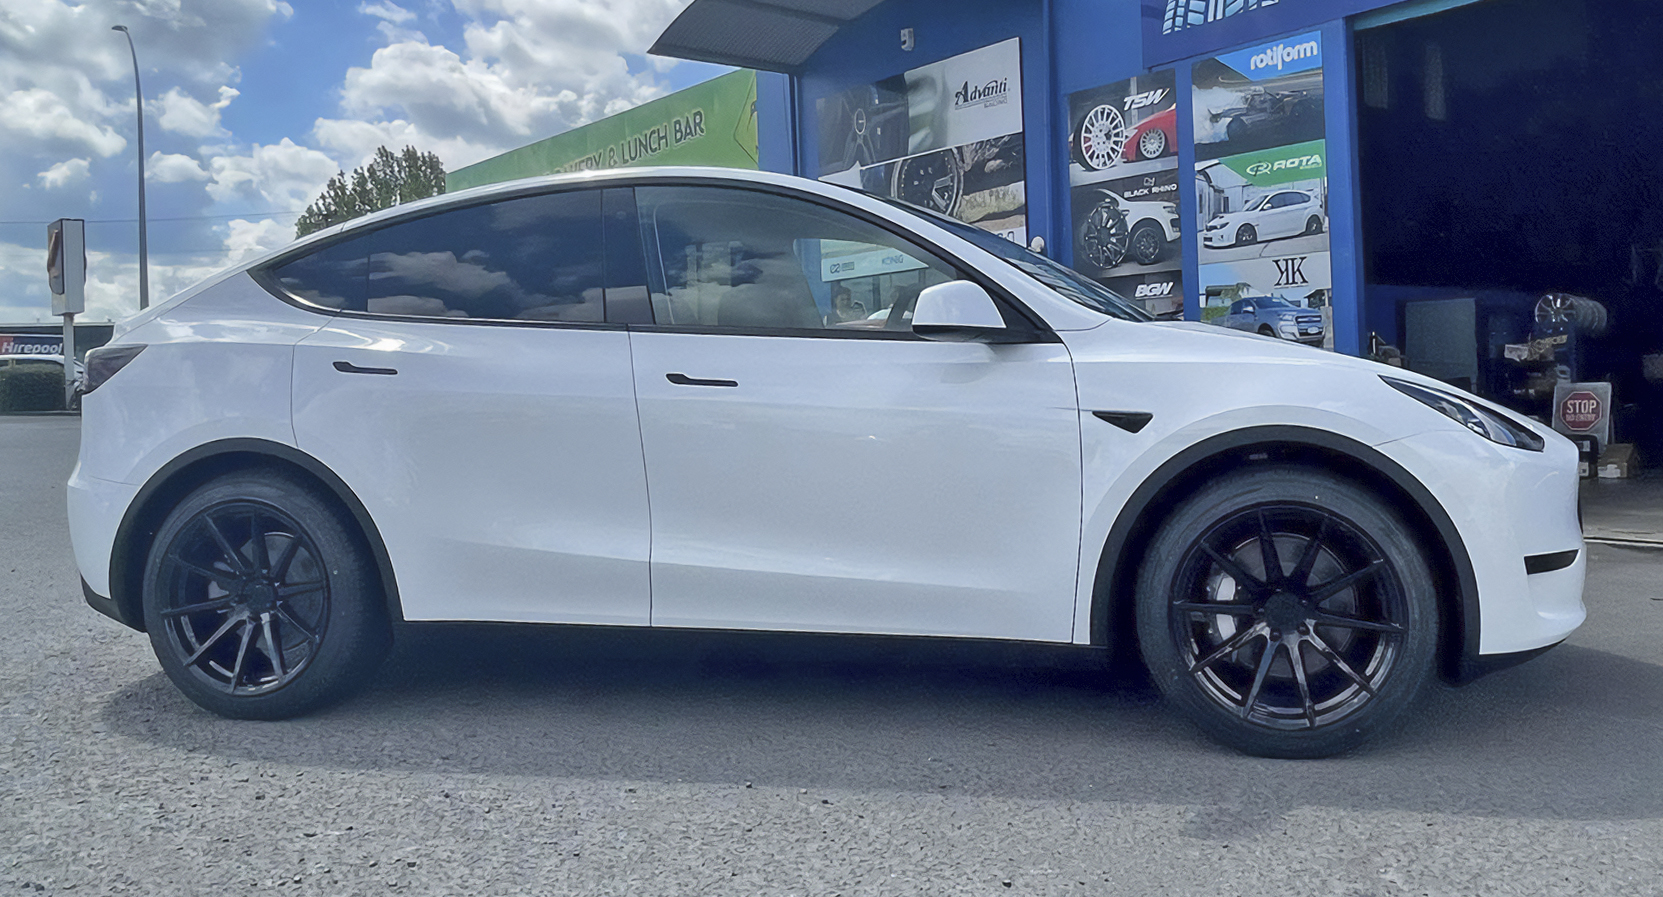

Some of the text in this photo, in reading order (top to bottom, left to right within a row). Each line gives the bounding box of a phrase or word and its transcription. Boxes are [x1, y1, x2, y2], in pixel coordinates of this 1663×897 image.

[1250, 41, 1318, 70] rotiform
[955, 77, 1007, 105] Advanti
[1123, 88, 1170, 110] TSW
[607, 147, 618, 167] &
[621, 124, 669, 164] LUNCH
[673, 110, 705, 144] BAR
[1273, 155, 1322, 170] ROTA
[1124, 183, 1178, 198] BLACK RHINO
[1135, 282, 1173, 297] BGW
[2, 342, 63, 354] Hirepool
[1567, 399, 1597, 414] STOP
